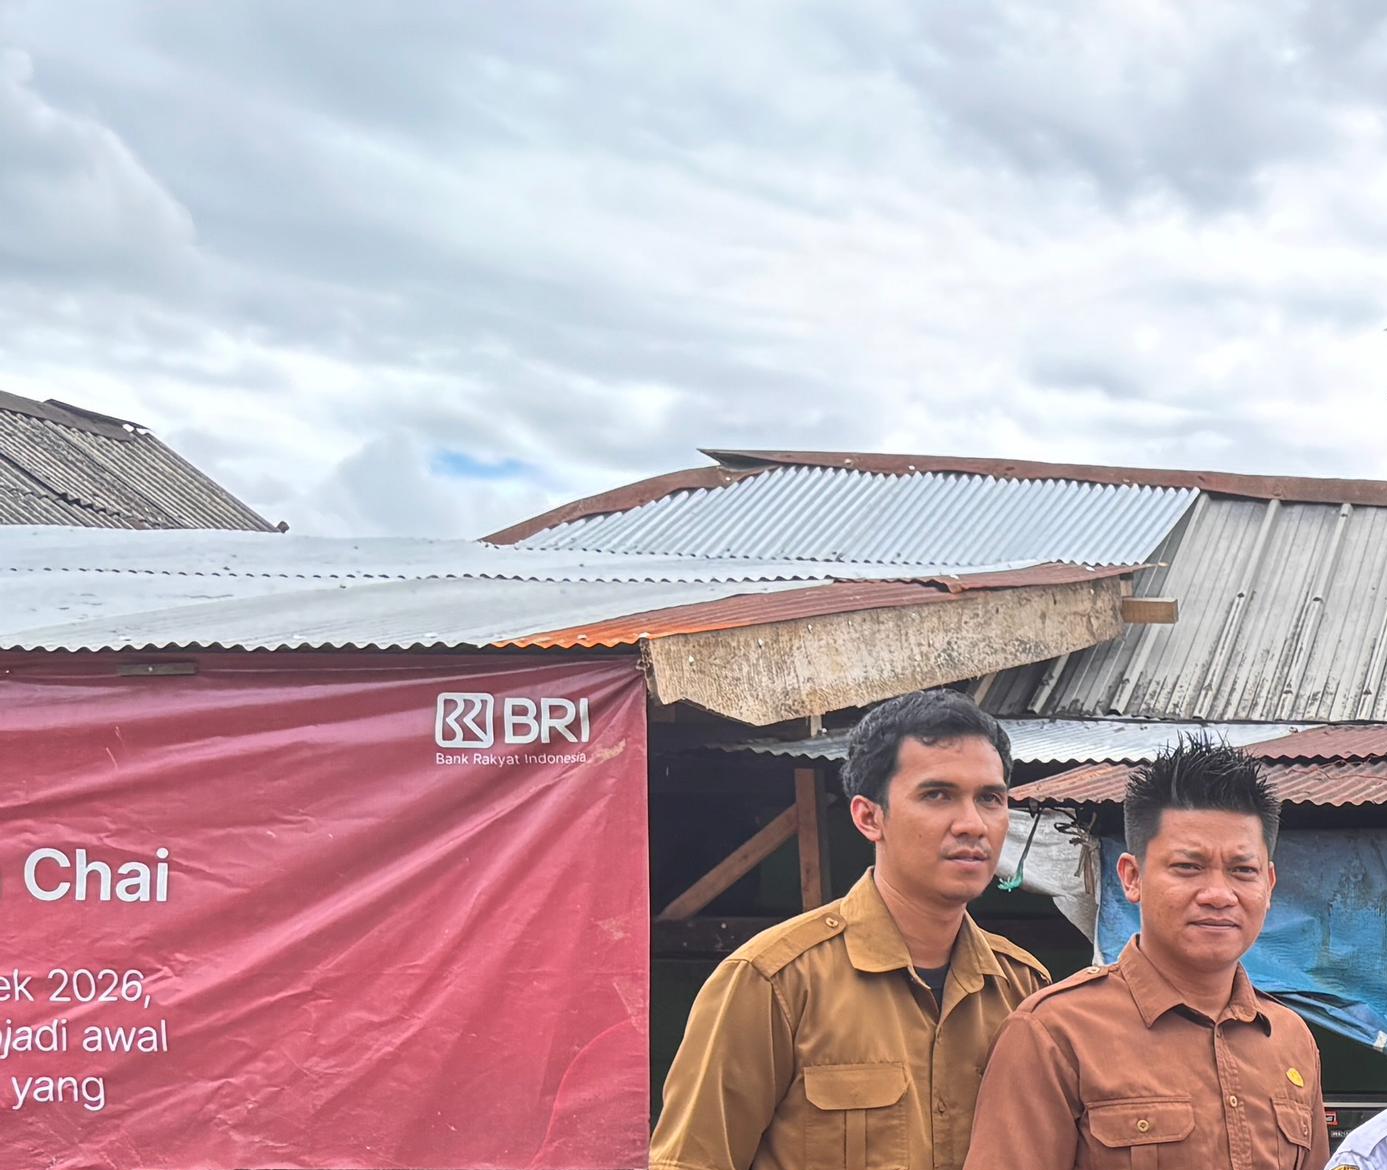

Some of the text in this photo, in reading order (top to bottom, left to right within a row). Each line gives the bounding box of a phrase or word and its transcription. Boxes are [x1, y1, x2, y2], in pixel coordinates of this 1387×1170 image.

[504, 697, 590, 744] BRI
[436, 753, 586, 768] Bank Rakyat Indonesia
[23, 848, 169, 902] Chai
[48, 968, 151, 1008] 2026,
[0, 1019, 169, 1060] jadi awal
[12, 1076, 105, 1111] yang
